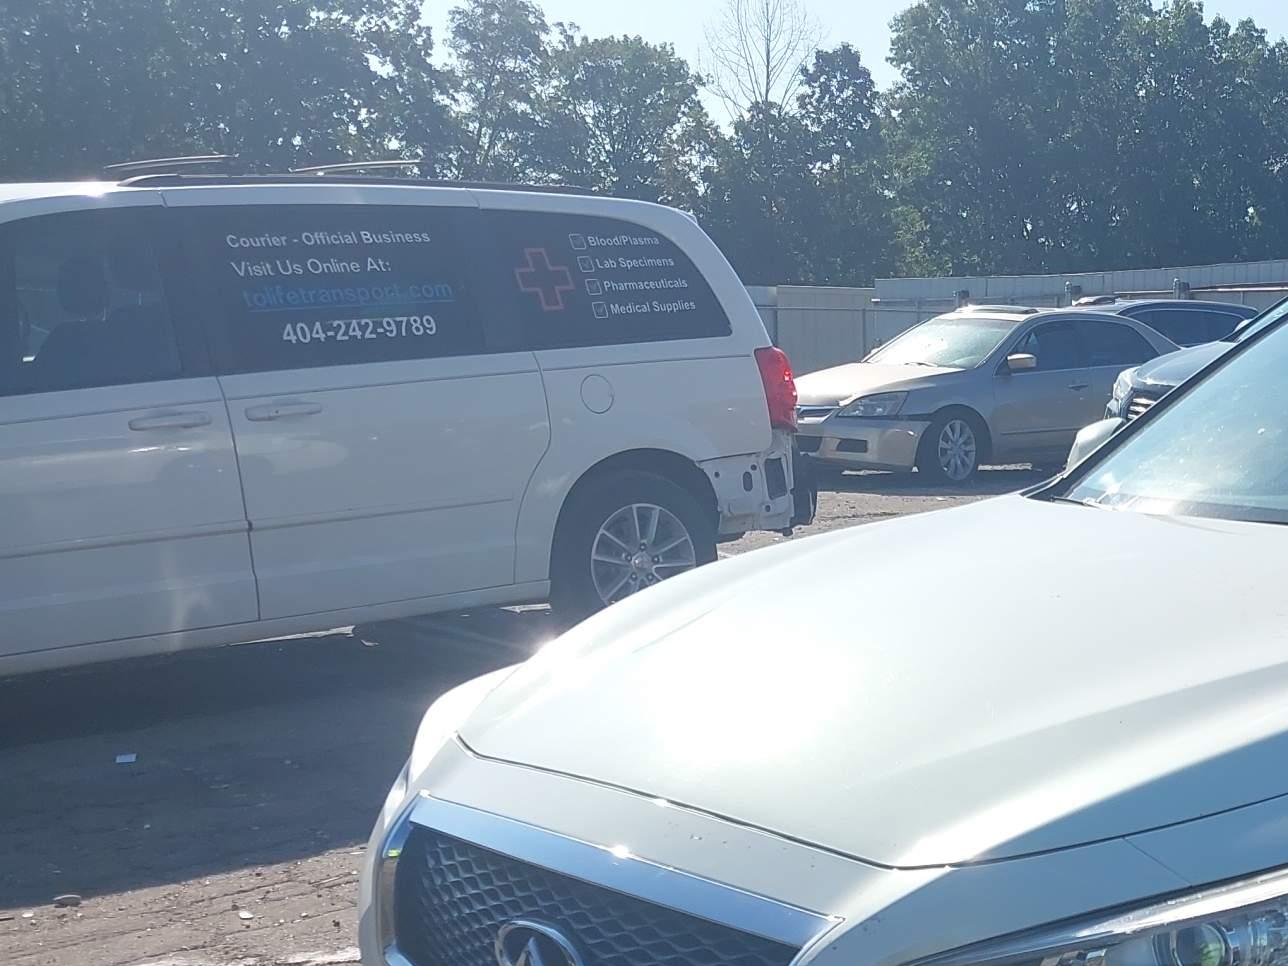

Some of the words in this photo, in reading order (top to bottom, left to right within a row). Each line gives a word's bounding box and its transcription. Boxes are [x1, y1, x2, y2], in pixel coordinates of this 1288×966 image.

[225, 233, 288, 248] Courier
[301, 231, 358, 246] Official
[360, 230, 431, 244] Business
[587, 234, 660, 247] Blood/Plasma
[230, 260, 276, 278] Visit
[276, 259, 303, 276] Us
[307, 258, 361, 275] Online
[367, 257, 392, 273] At:
[596, 257, 617, 269] Lab
[619, 256, 675, 269] Specimens
[603, 278, 688, 292] Pharmaceuticals
[610, 302, 650, 315] Medical
[652, 300, 696, 313] Supplies
[283, 315, 437, 344] 404-242-9789
